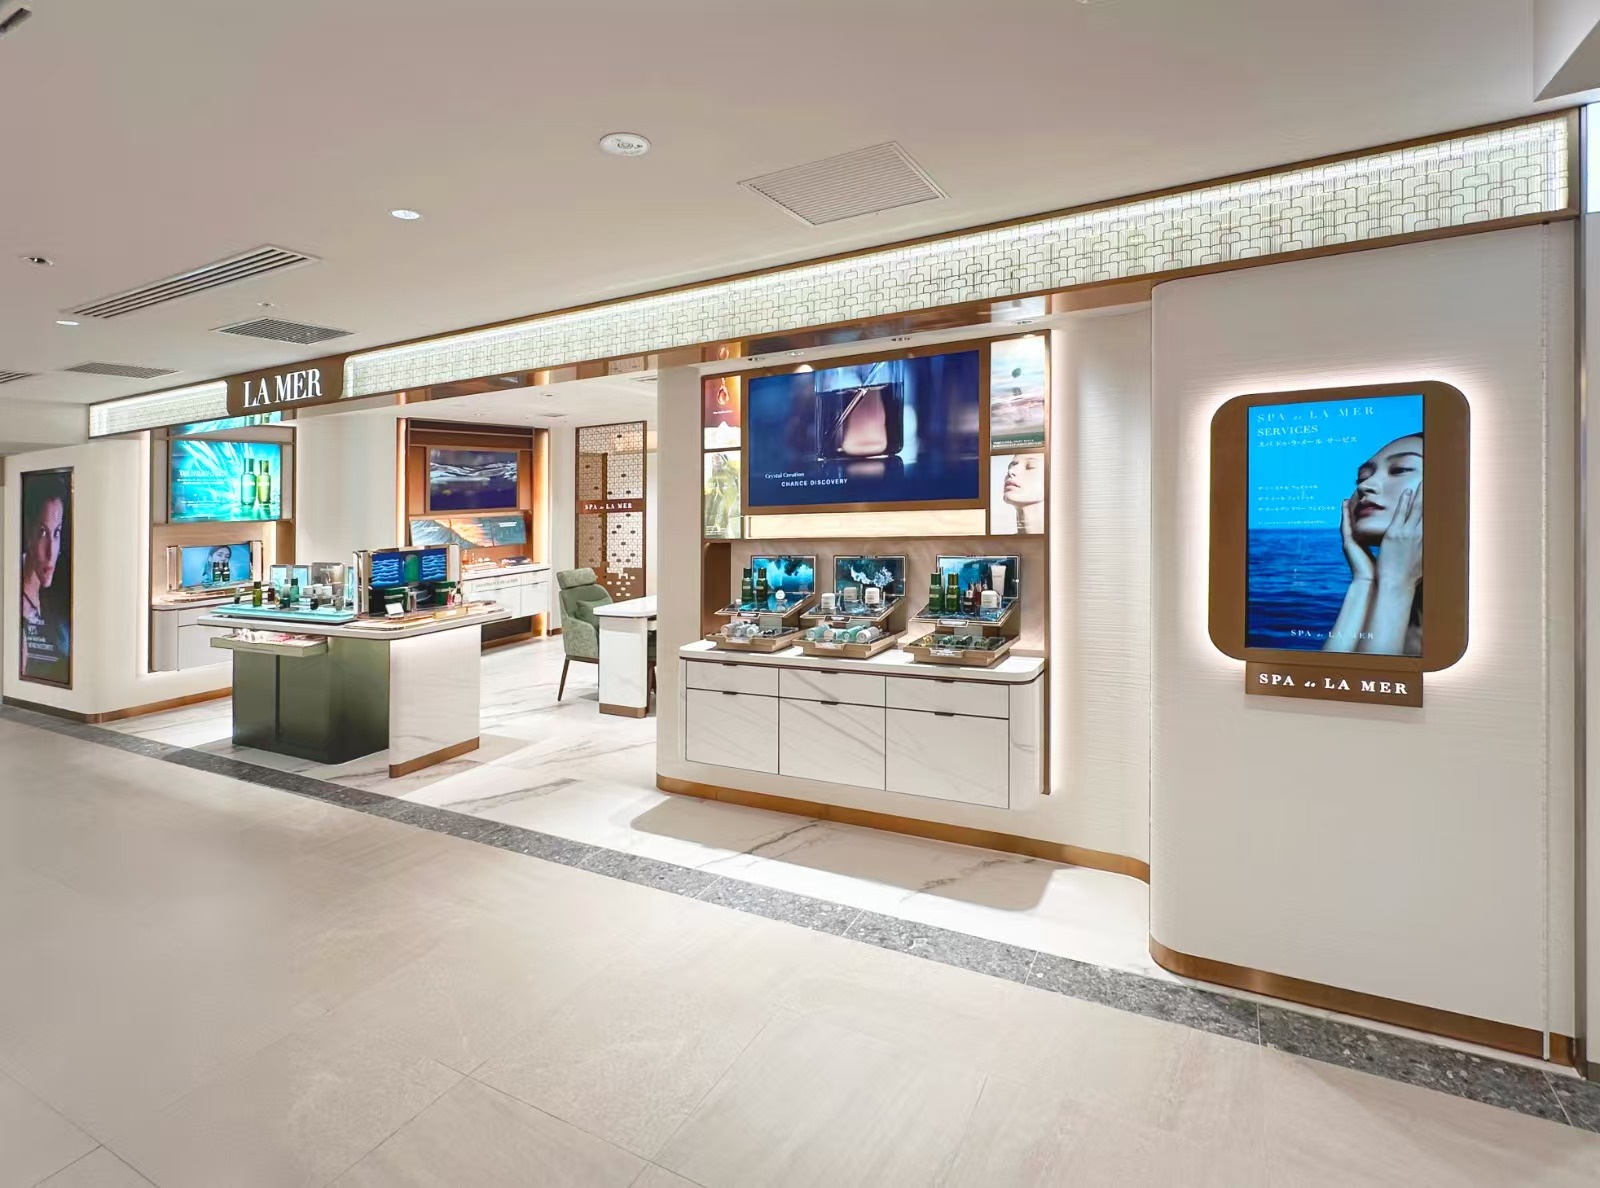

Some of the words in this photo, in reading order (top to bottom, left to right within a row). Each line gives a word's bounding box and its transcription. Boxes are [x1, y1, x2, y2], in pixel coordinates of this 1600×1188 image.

[243, 377, 271, 408] LA
[274, 368, 323, 403] MER
[1257, 413, 1286, 423] SPA
[1310, 409, 1330, 419] LA
[1339, 406, 1374, 416] MER
[1257, 425, 1318, 437] SERVICES
[810, 478, 848, 486] DISCOVERY
[1290, 629, 1312, 637] SPA
[1259, 673, 1295, 687] SPA
[1304, 680, 1316, 688] de
[1324, 677, 1350, 691] LA
[1361, 680, 1408, 695] MER
